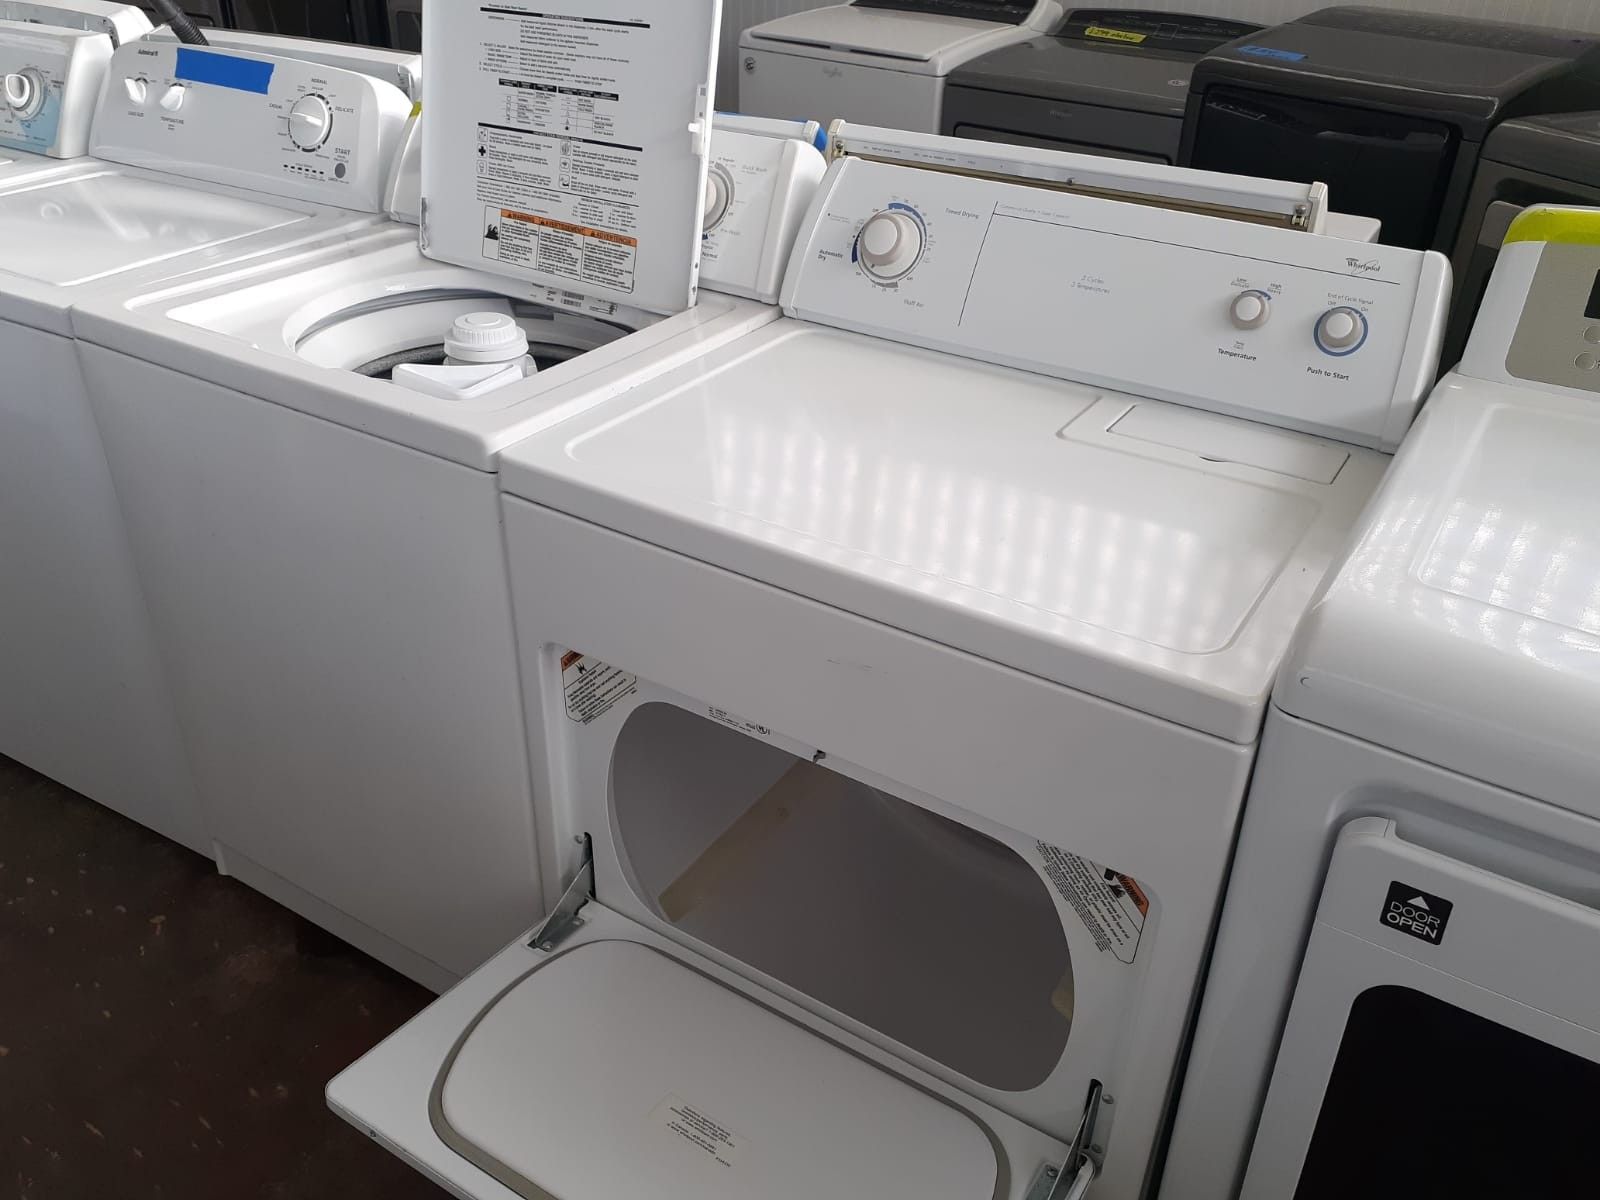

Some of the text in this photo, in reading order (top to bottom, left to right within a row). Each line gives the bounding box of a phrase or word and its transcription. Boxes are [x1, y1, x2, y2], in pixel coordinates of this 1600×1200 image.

[335, 148, 350, 156] START
[945, 208, 979, 220] Timed Drying
[819, 249, 843, 258] Automatic
[1346, 257, 1381, 275] Whirlpool
[1077, 282, 1110, 294] Temperatures
[1218, 348, 1256, 361] Temperature
[1306, 366, 1349, 381] Push to Start
[1390, 901, 1440, 928] DOOR
[1386, 912, 1437, 939] OPEN
